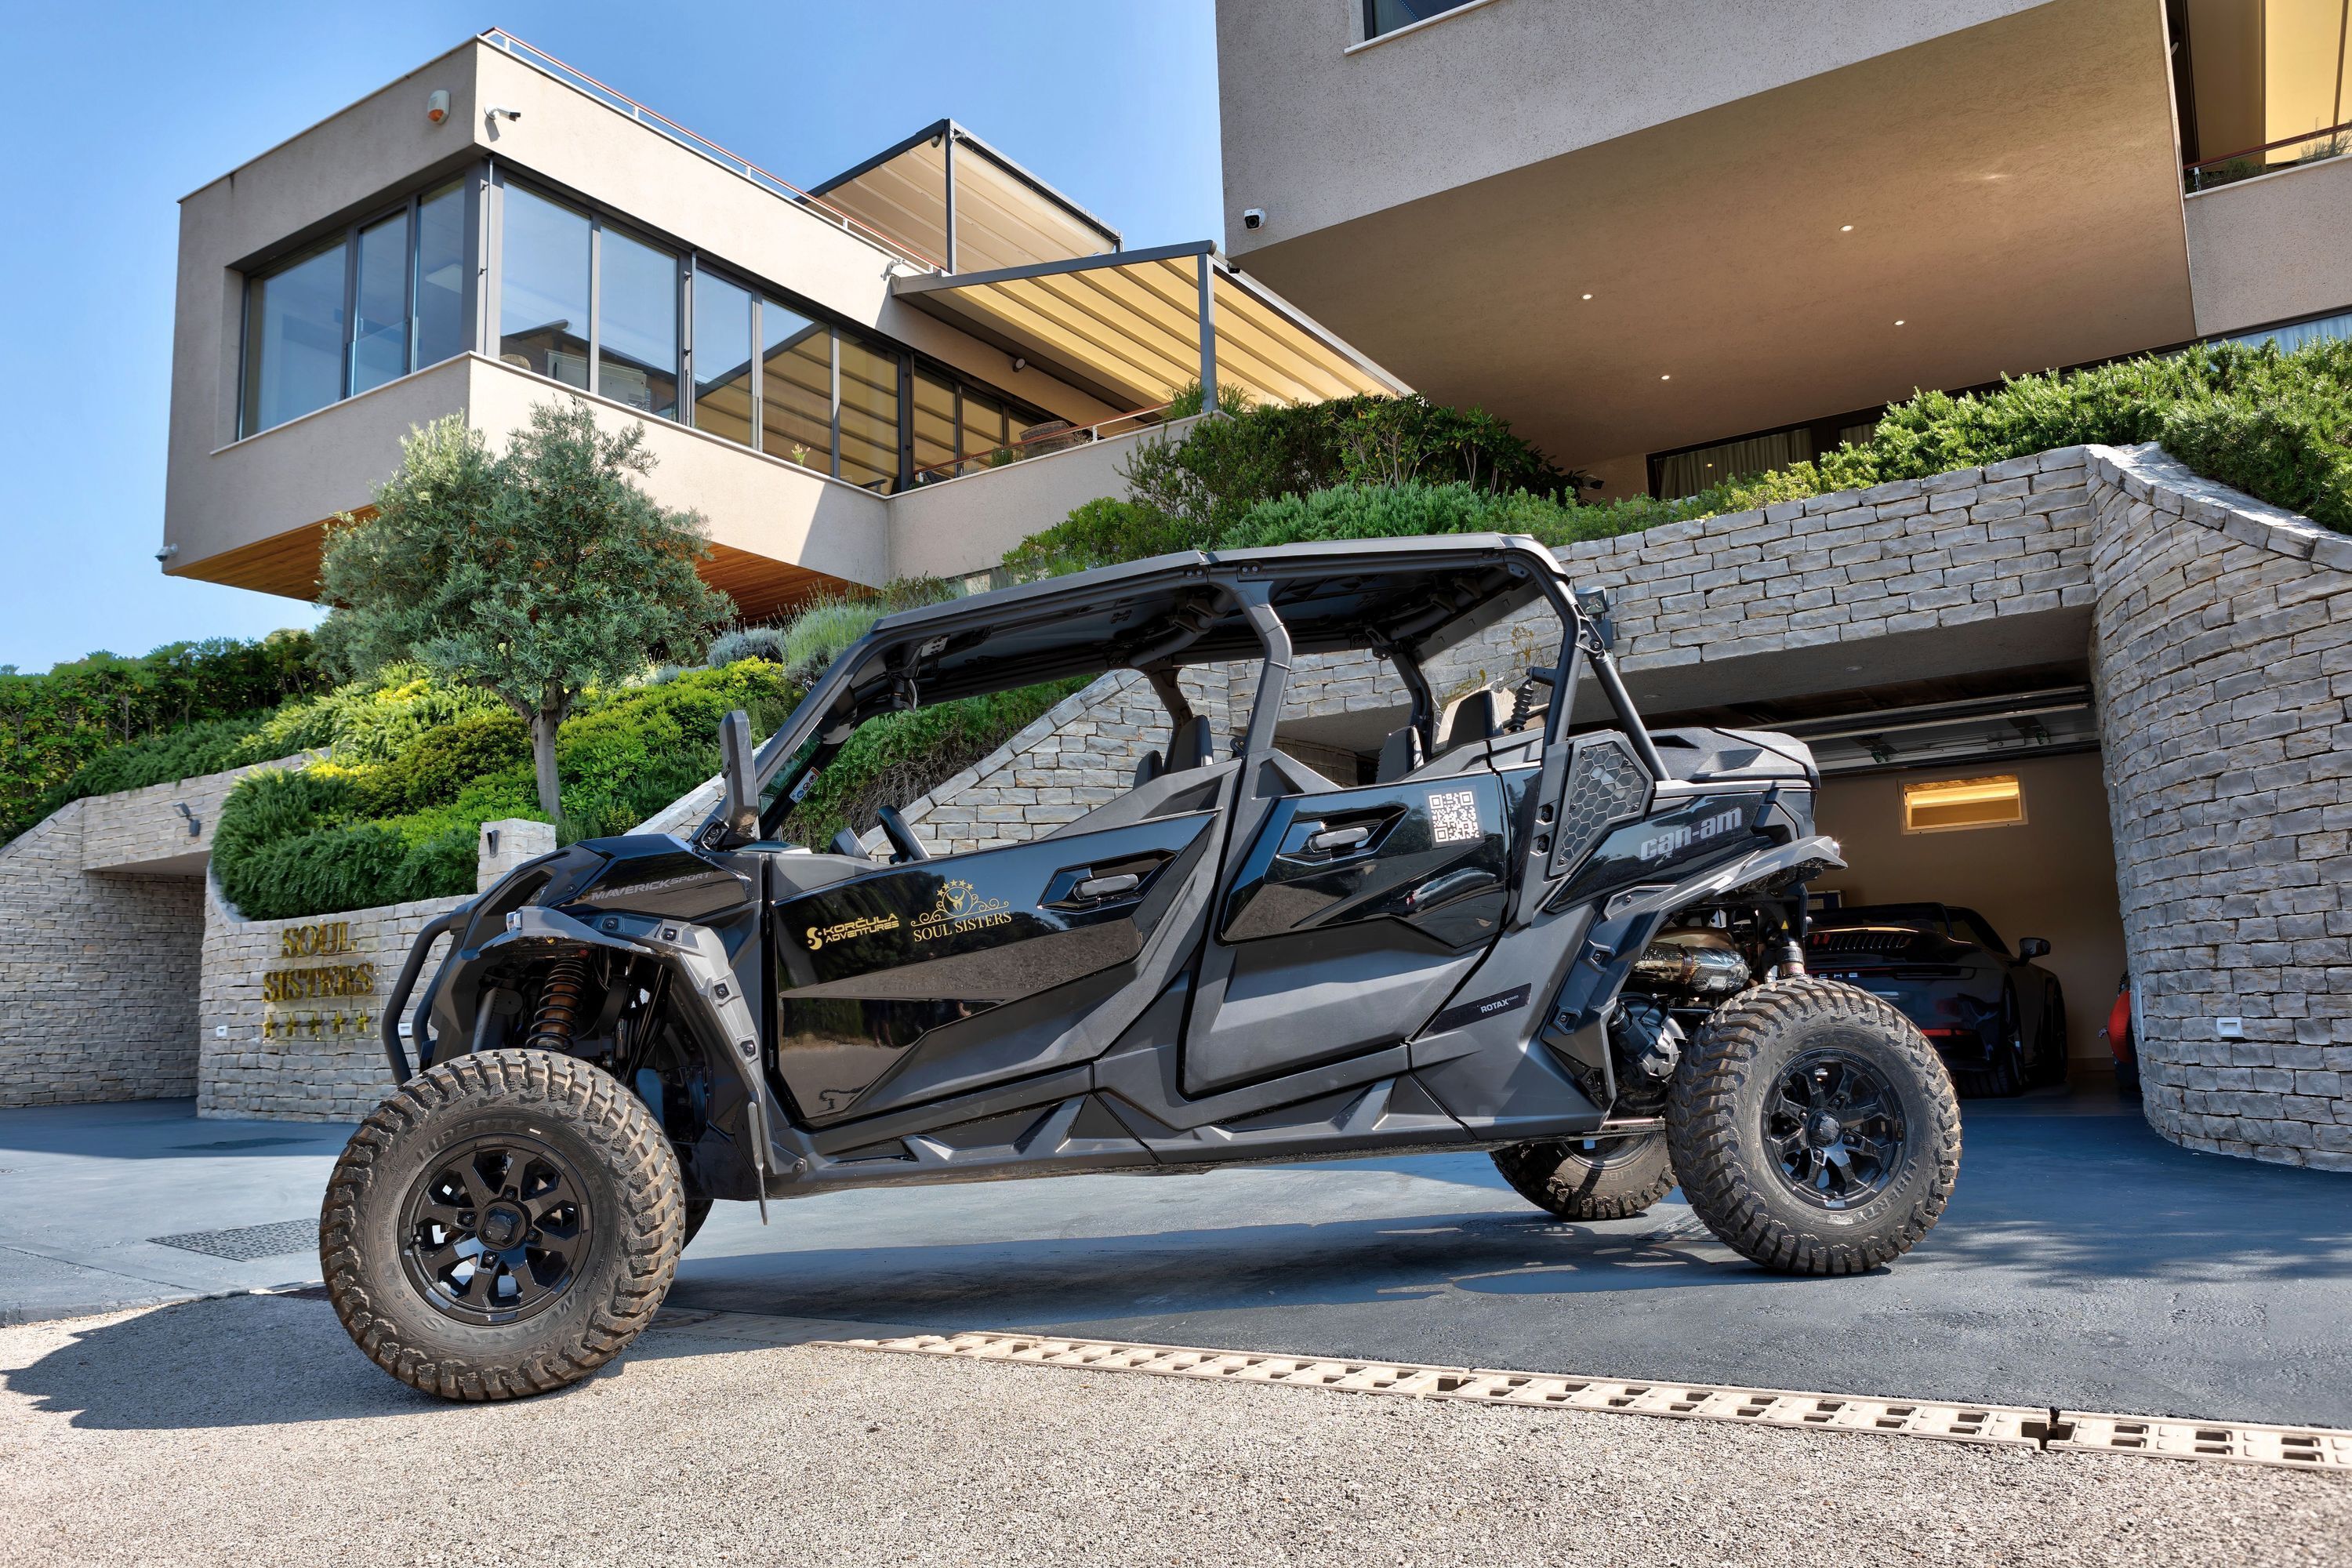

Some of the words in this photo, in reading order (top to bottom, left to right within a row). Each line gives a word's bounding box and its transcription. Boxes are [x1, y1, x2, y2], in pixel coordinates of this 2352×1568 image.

[1640, 807, 1743, 861] can-am
[823, 913, 898, 935] KORČULA
[826, 920, 899, 943] ADVENTURES
[913, 924, 952, 942] SOUL
[954, 910, 1012, 933] SISTERS
[281, 921, 358, 958] SOUL
[263, 962, 375, 1002] SISTERS
[1480, 998, 1509, 1014] ROTAX
[1567, 1164, 1634, 1181] LIBETY
